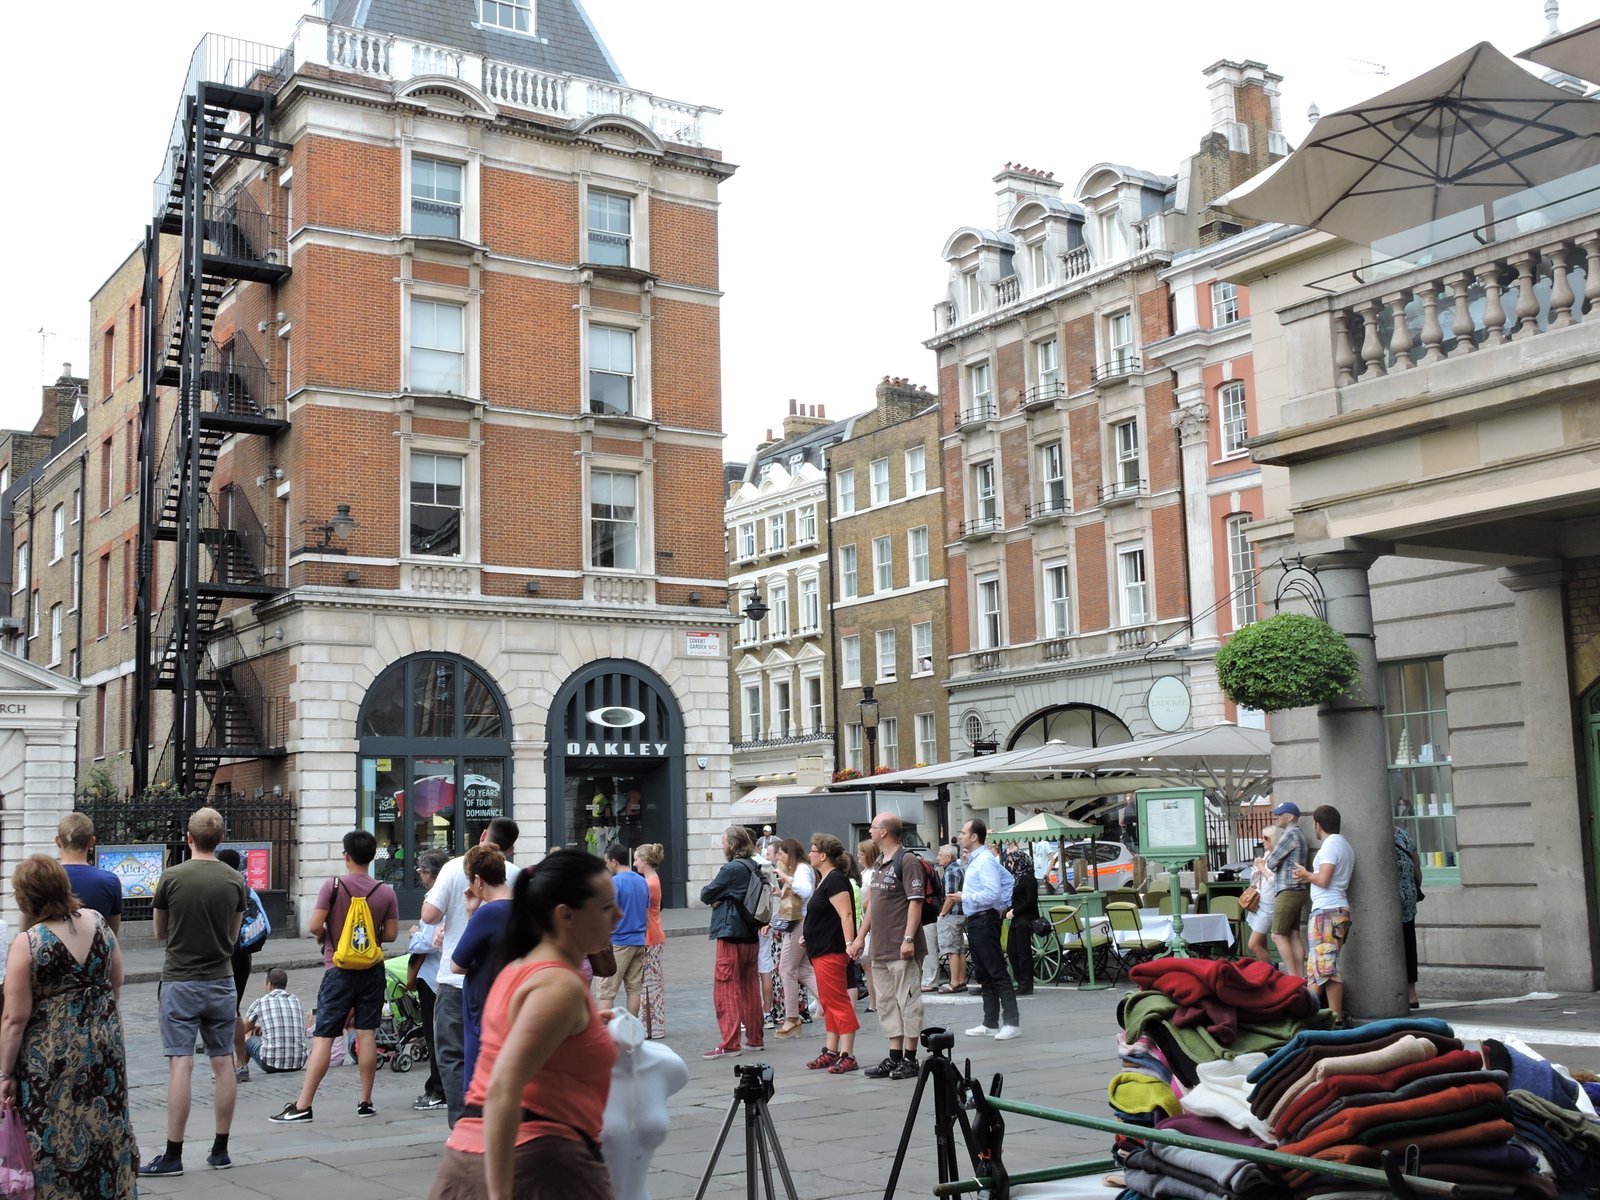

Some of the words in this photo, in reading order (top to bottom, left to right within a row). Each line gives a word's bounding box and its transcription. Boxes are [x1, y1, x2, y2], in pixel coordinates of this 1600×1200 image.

[567, 742, 667, 755] OAKLEY
[466, 789, 476, 797] 30
[477, 789, 499, 797] YEARS
[466, 799, 475, 807] OF
[476, 799, 493, 807] TOUR
[466, 809, 504, 817] DOMINANCE
